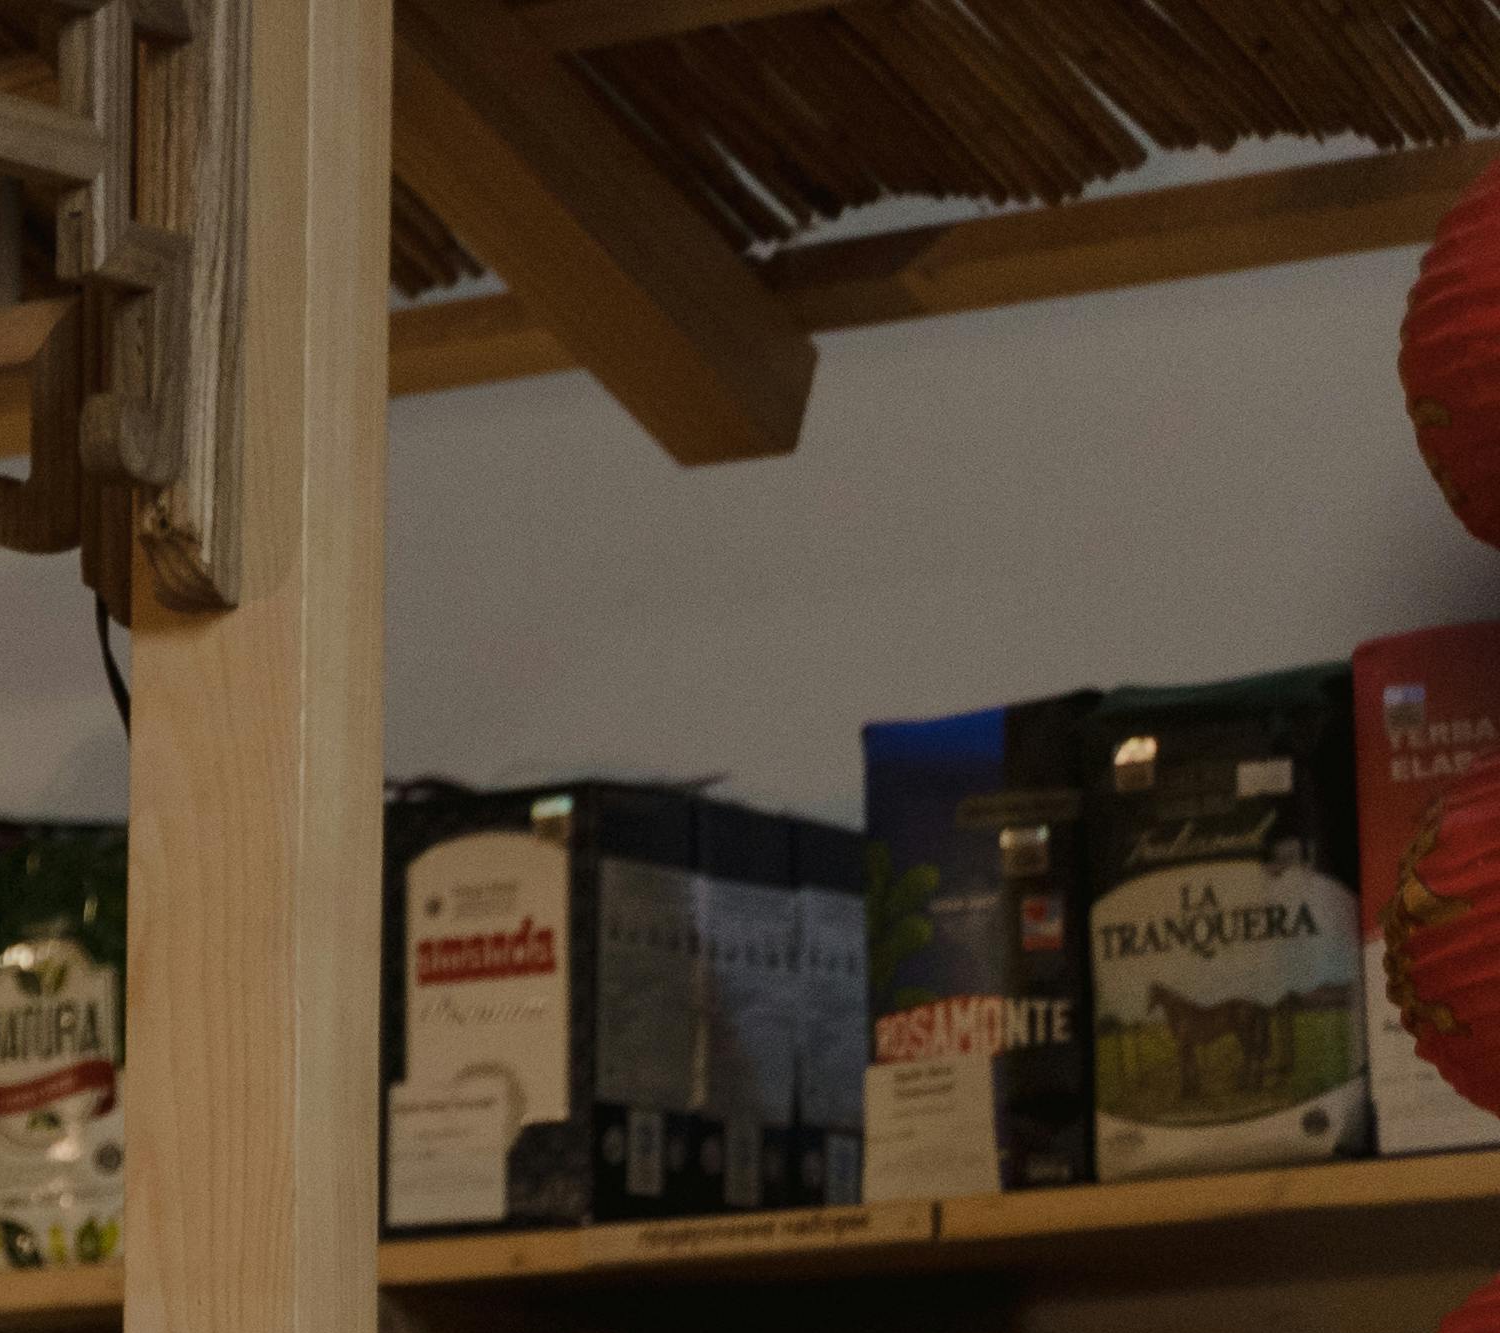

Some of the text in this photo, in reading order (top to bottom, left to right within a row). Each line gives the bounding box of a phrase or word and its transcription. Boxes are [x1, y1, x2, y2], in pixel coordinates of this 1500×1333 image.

[1180, 883, 1218, 907] LA
[1099, 902, 1319, 962] TRANQUERA
[874, 995, 1072, 1064] ROSAMONTE
